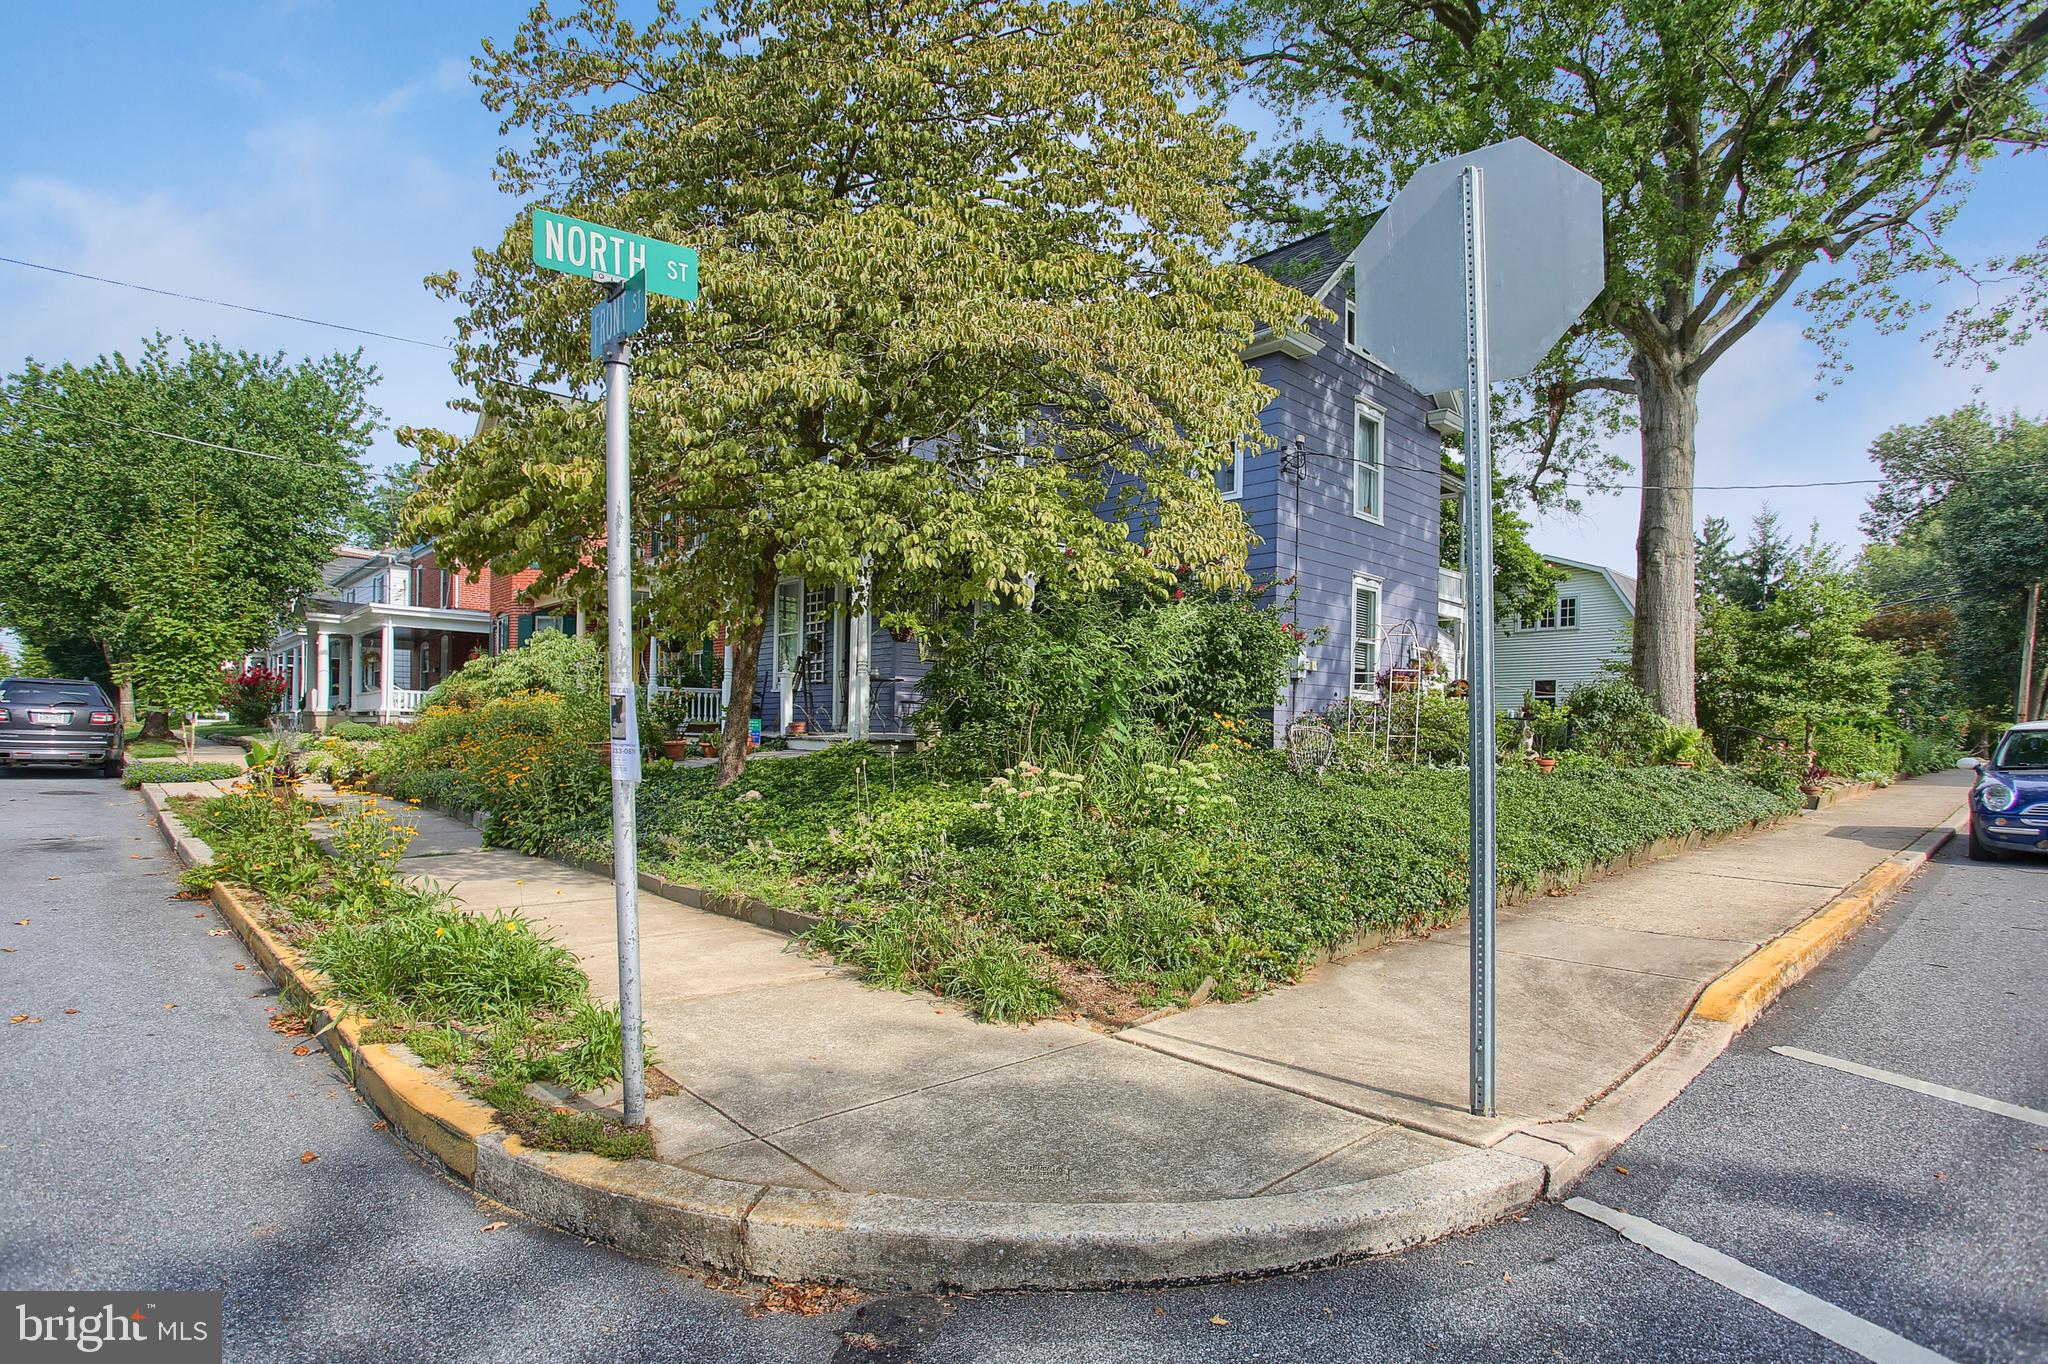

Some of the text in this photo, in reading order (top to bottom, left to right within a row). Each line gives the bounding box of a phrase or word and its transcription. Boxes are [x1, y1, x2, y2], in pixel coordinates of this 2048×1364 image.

[545, 219, 689, 283] NORTH ST
[594, 289, 641, 350] FRONT ST
